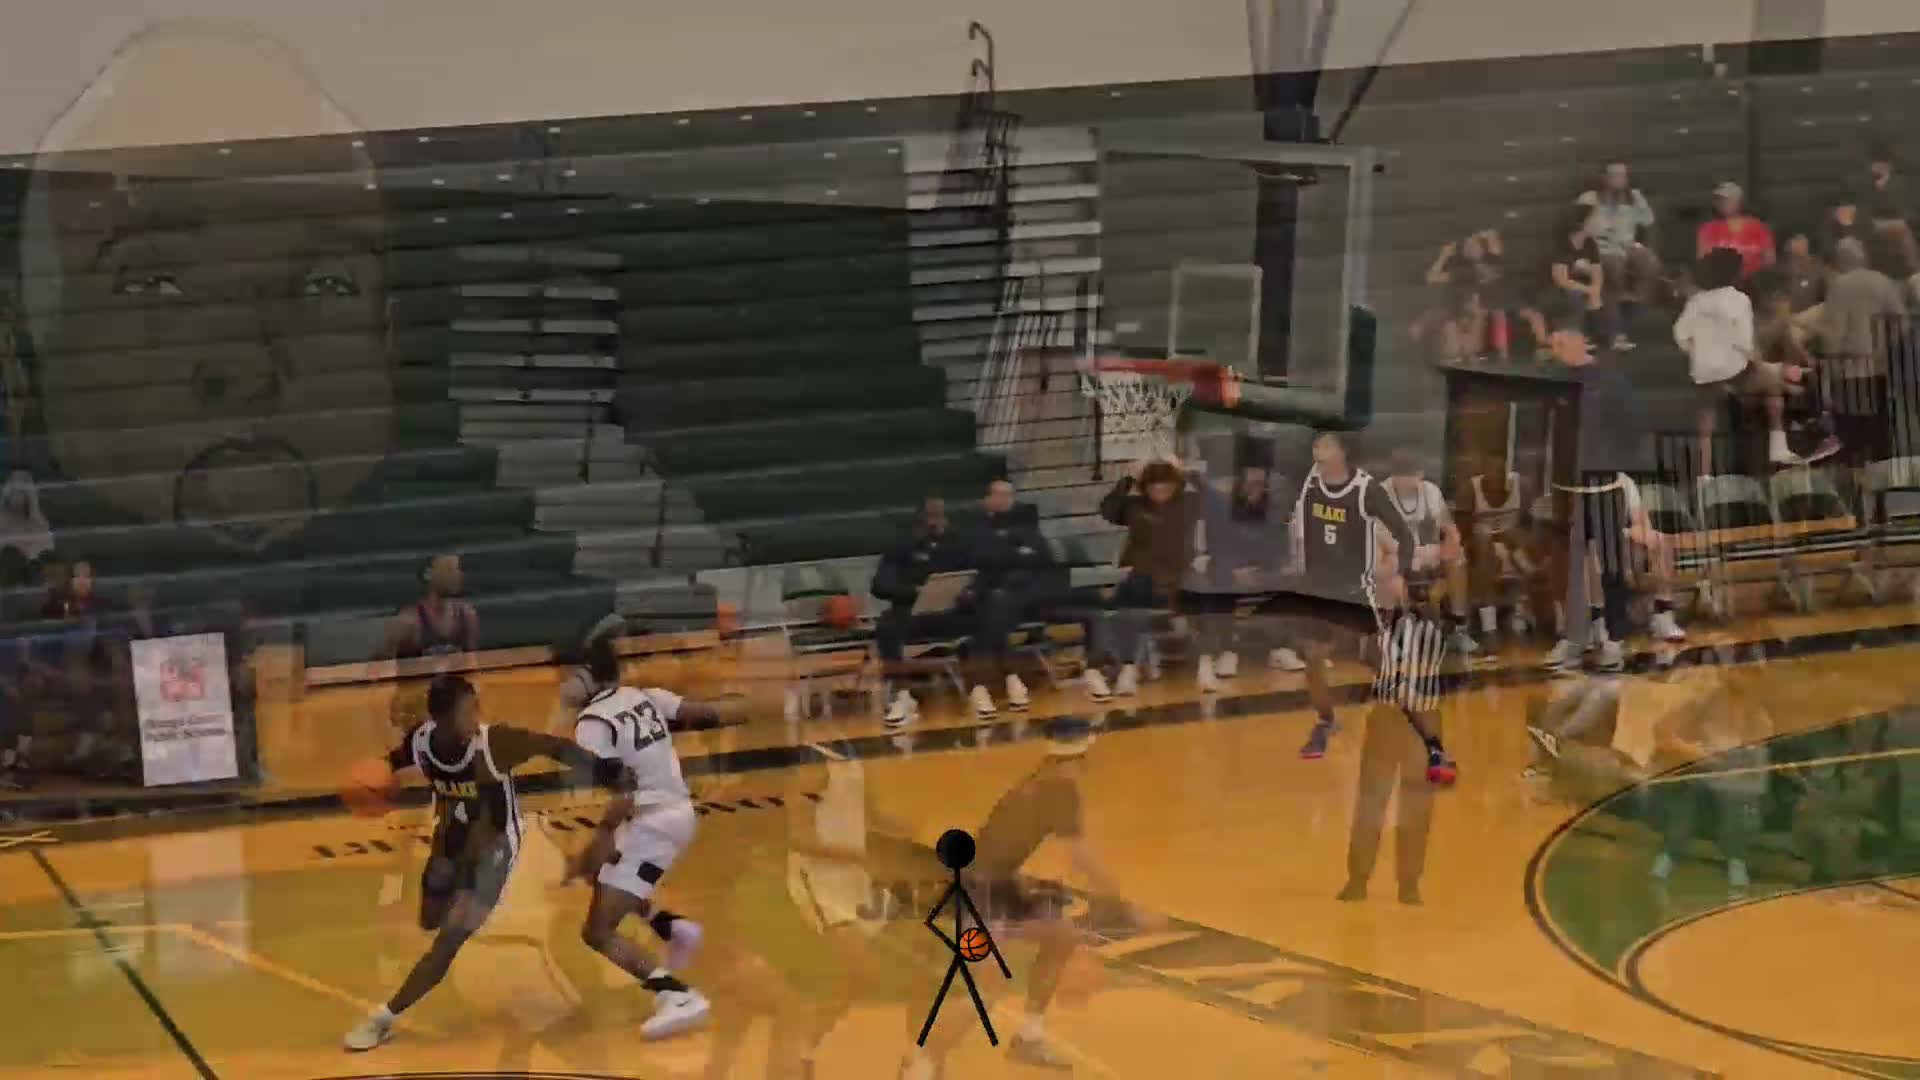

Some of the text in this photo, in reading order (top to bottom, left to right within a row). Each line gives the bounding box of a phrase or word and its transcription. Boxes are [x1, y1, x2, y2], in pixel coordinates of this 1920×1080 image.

[1312, 503, 1346, 522] BLAKE
[1324, 524, 1337, 545] 5
[614, 700, 666, 751] 23
